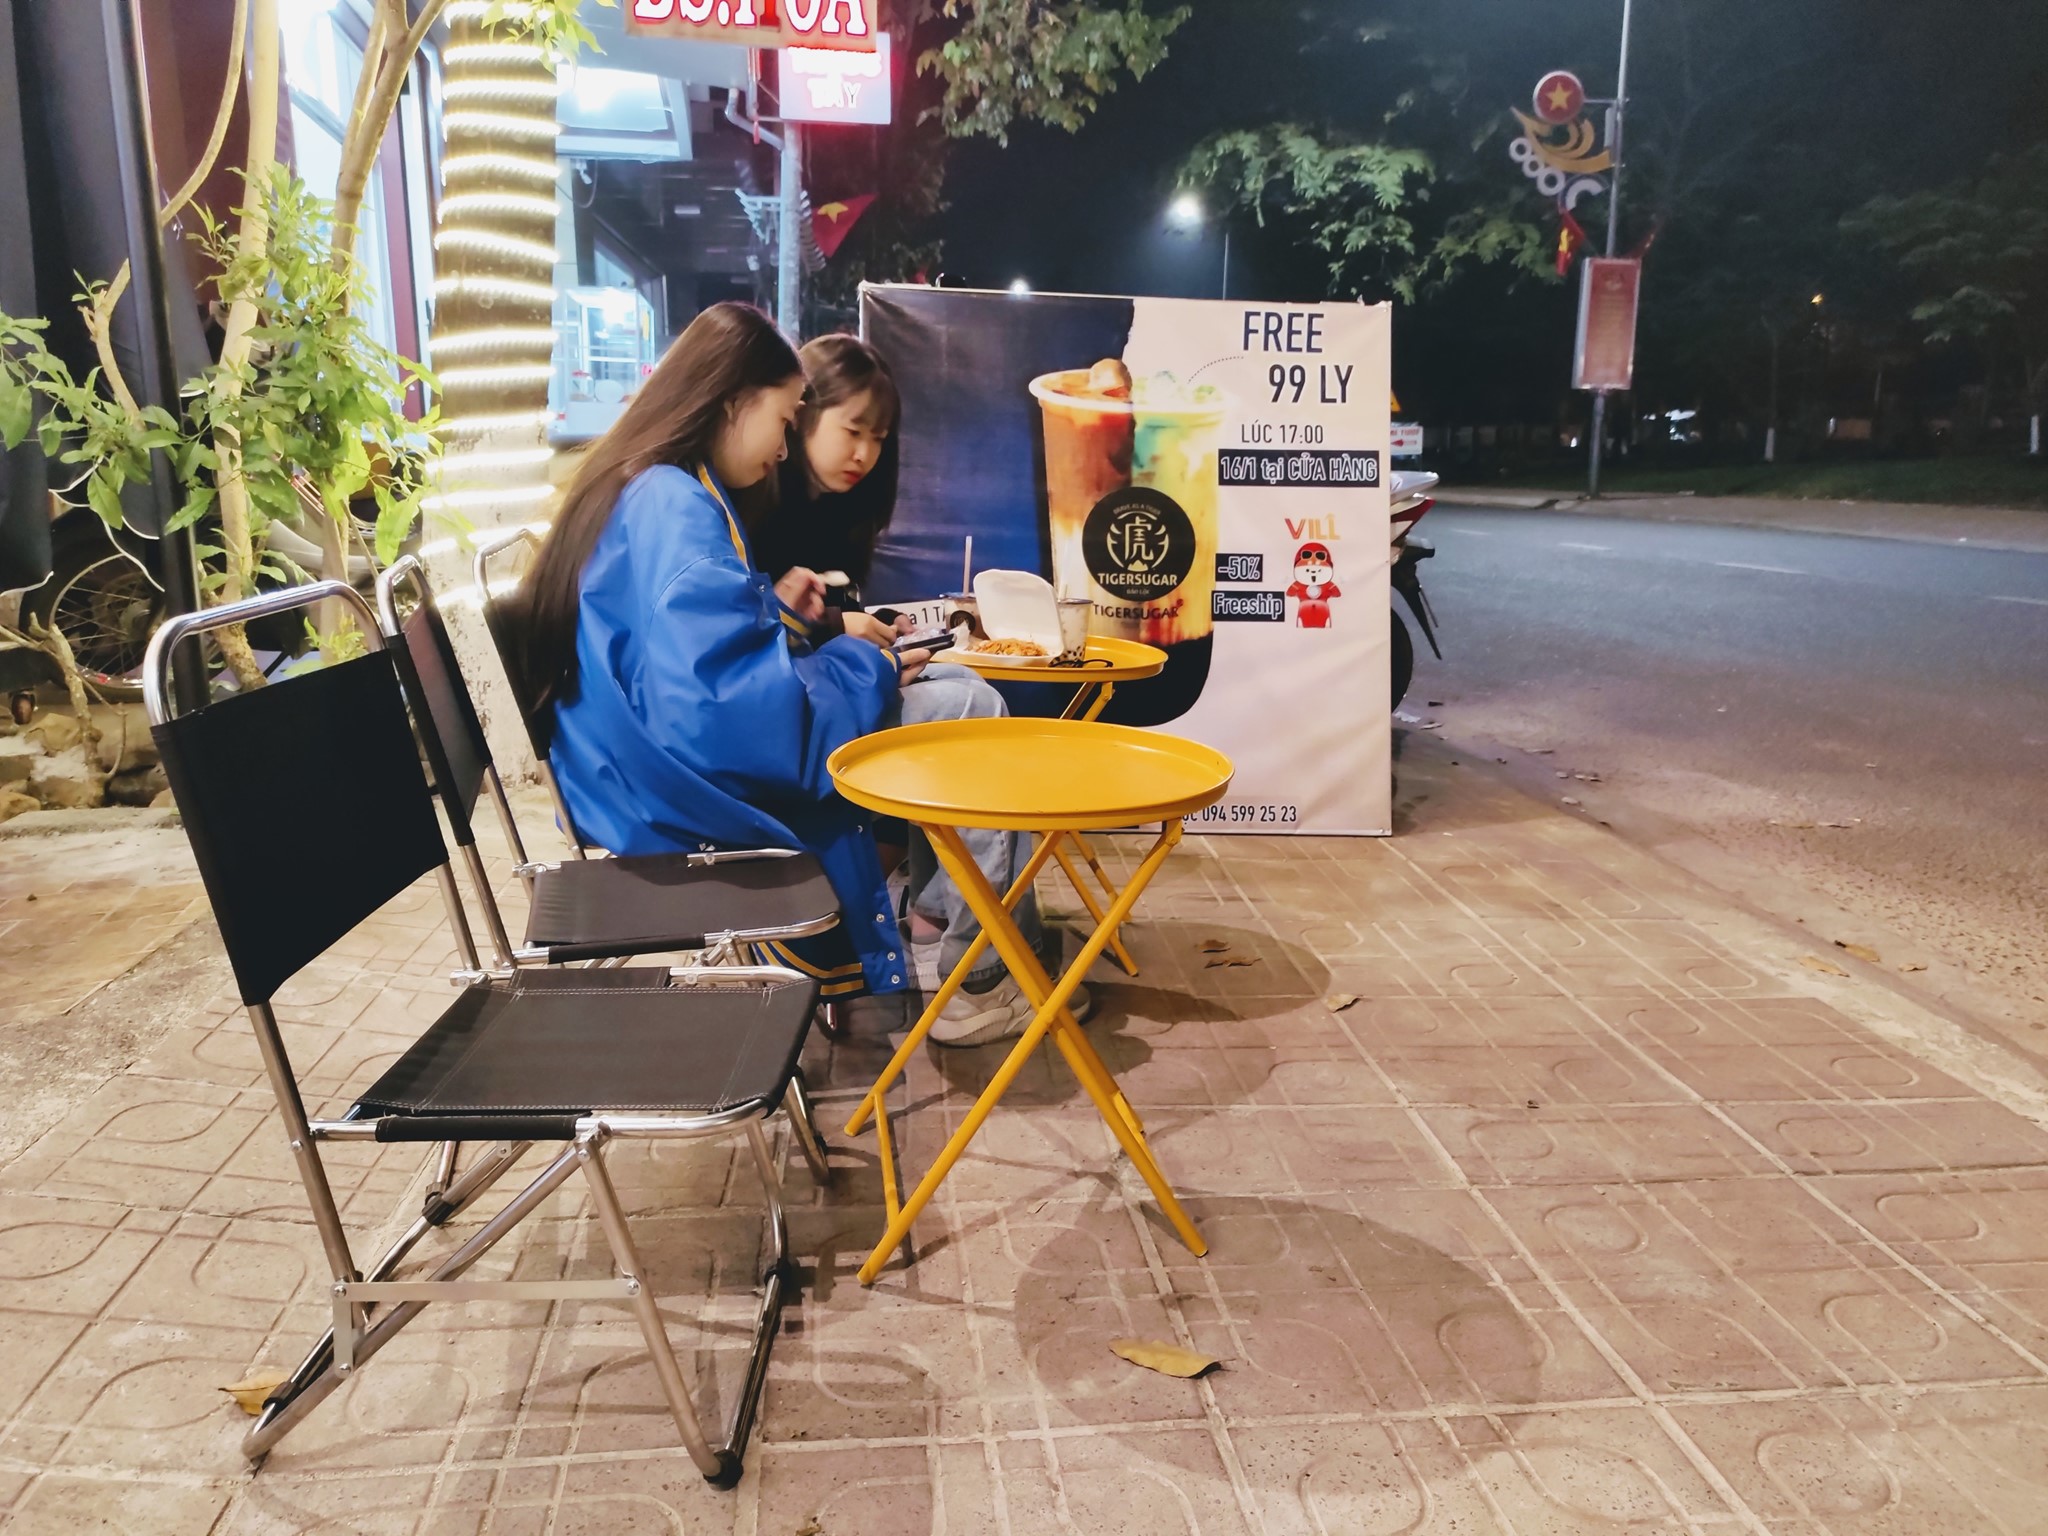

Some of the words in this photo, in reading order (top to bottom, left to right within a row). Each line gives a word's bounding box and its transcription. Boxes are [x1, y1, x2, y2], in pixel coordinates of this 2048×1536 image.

[1243, 311, 1324, 353] FREE
[1268, 364, 1306, 404] 99
[1320, 364, 1354, 404] LY
[1241, 419, 1272, 444] LÚC
[1280, 424, 1324, 444] 17:00
[1220, 456, 1256, 480] 16/1
[1261, 458, 1284, 484] tại
[1288, 452, 1326, 481] CỬA
[1329, 453, 1377, 481] HÀNG
[1097, 572, 1178, 586] TIGERSUGAR
[1218, 555, 1261, 580] -50%
[1093, 604, 1179, 620] TIGERSUGAR
[1213, 594, 1283, 618] Freeship
[1202, 805, 1226, 822] 094
[1231, 805, 1255, 822] 599
[1260, 805, 1276, 822] 25
[1281, 805, 1297, 822] 23
